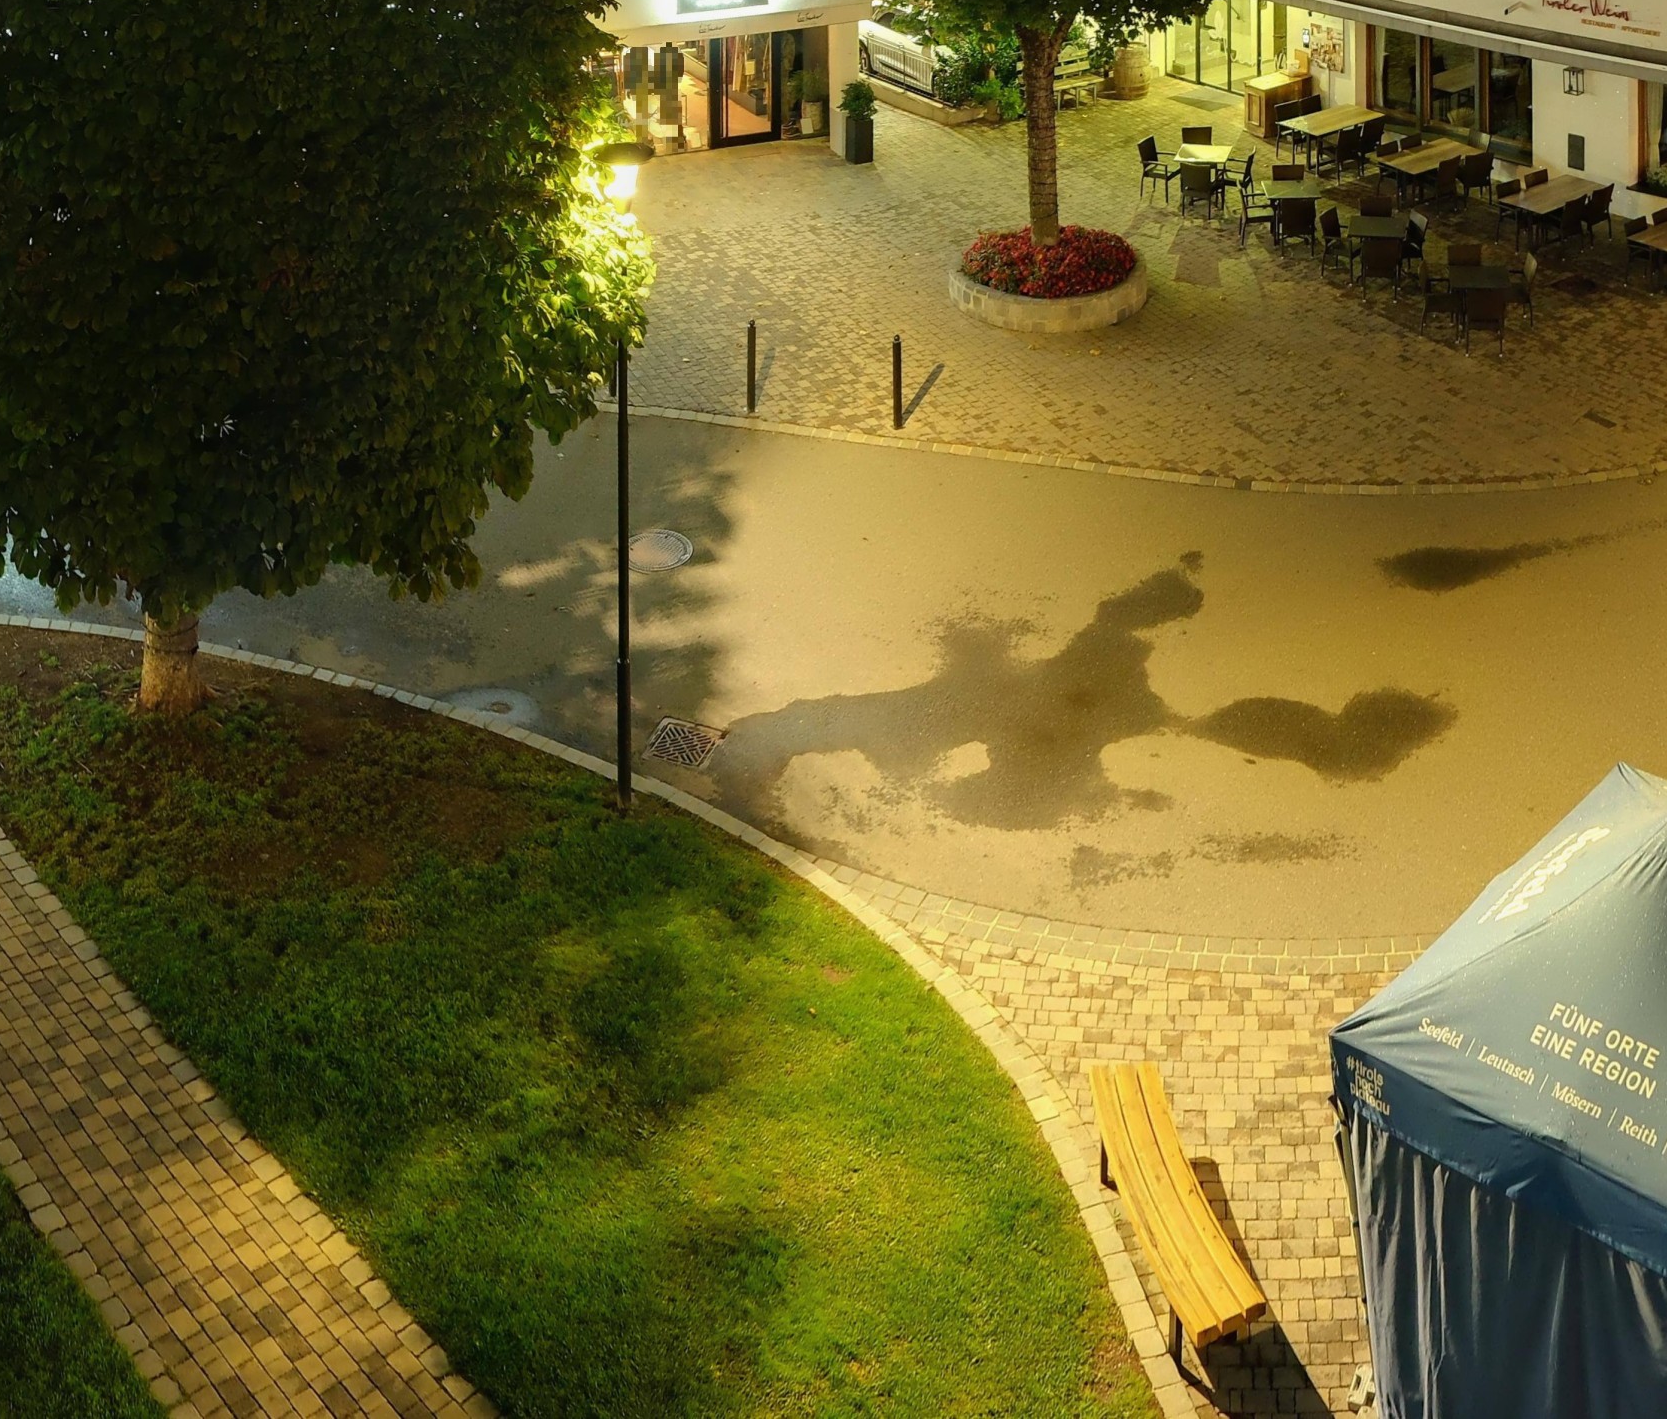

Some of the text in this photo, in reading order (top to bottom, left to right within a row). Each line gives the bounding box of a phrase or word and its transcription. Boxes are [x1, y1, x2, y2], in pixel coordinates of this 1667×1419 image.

[1529, 1023, 1658, 1099] EINE REGION
[1548, 1001, 1661, 1070] FÜNF ORTE
[1346, 1054, 1384, 1087] #tirols
[1355, 1070, 1382, 1099] hoch
[1418, 1016, 1465, 1049] Seefeld
[1476, 1043, 1537, 1086] Leutasch
[1550, 1081, 1604, 1120] Mösern
[1618, 1114, 1658, 1148] Reith
[1349, 1082, 1391, 1116] plateau
